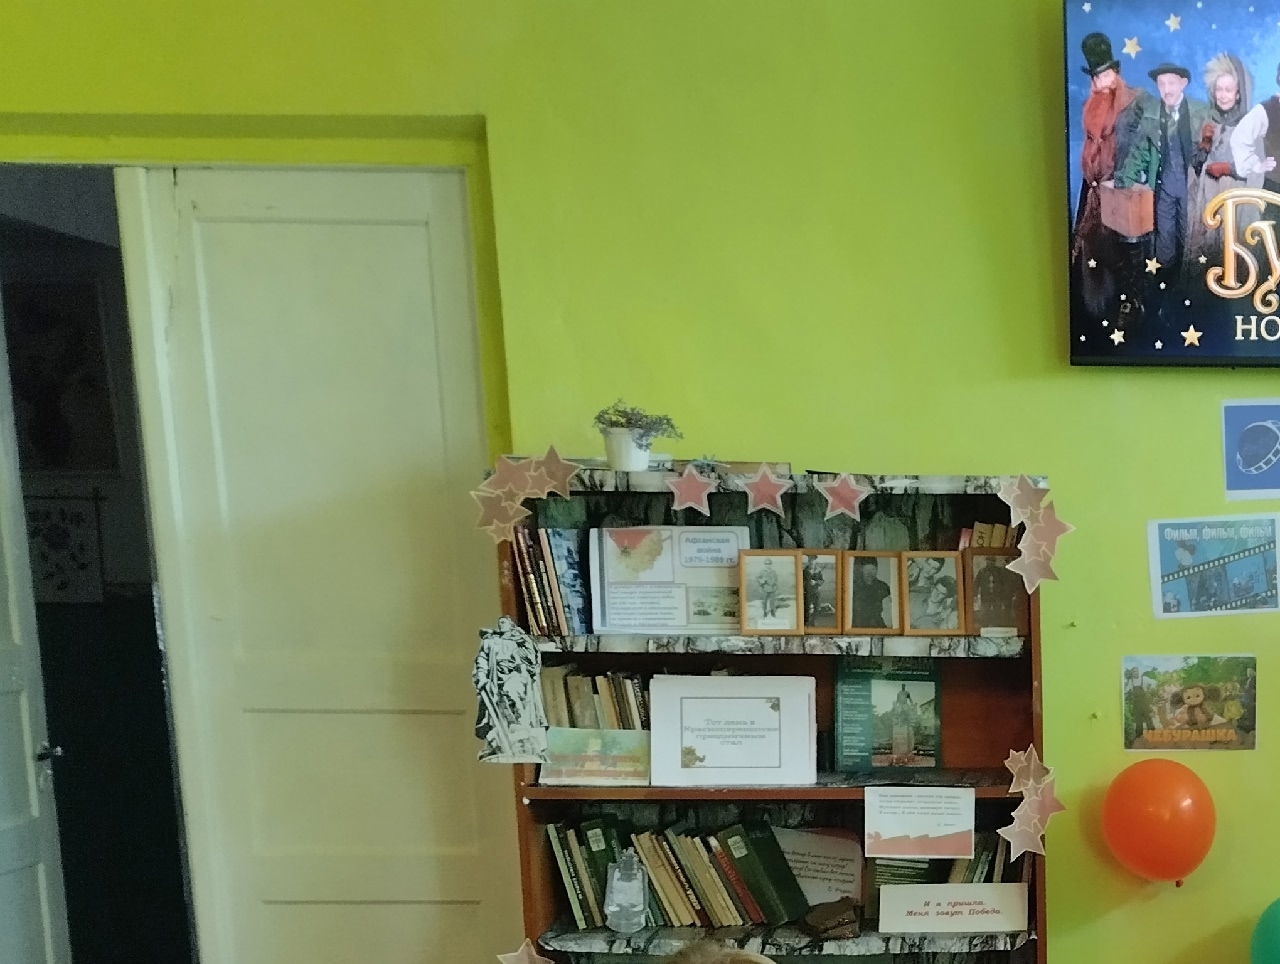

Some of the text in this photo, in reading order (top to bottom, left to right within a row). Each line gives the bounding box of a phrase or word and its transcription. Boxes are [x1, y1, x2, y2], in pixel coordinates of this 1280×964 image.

[696, 546, 721, 554] война
[1143, 728, 1238, 744] ЧЕБУРАШКА
[905, 909, 929, 917] Меня
[935, 910, 964, 918] зовут
